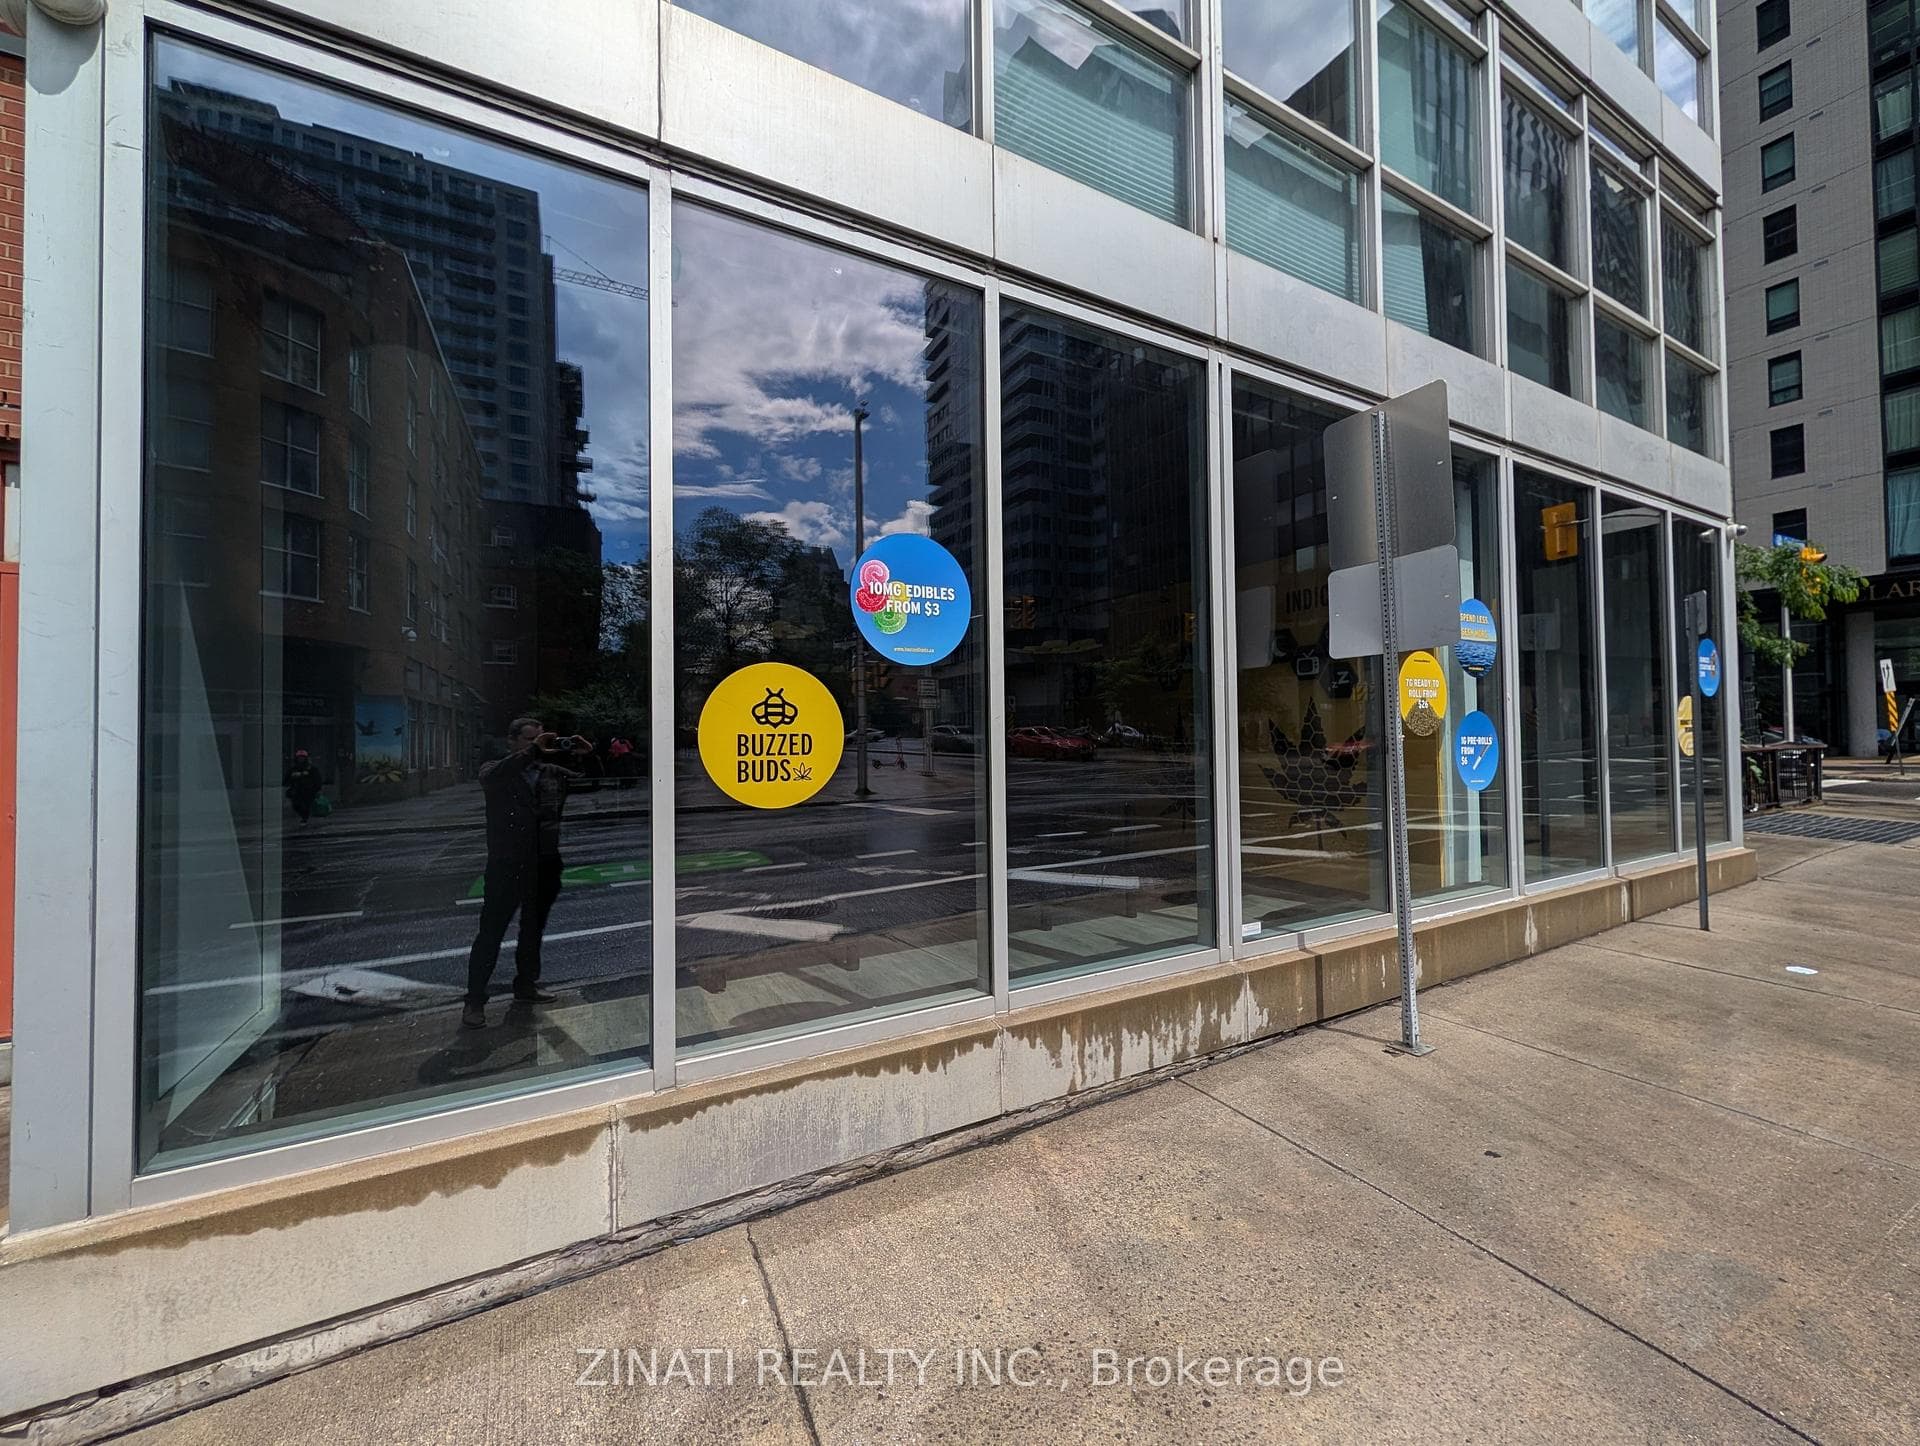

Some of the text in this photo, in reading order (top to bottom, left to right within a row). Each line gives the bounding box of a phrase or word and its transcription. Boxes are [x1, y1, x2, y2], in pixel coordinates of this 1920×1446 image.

[869, 581, 955, 601] 10MG EDIBLES
[1286, 585, 1329, 614] INDIC
[886, 599, 940, 617] FROM $3
[1413, 679, 1431, 687] READY
[1432, 679, 1440, 688] TO
[1408, 689, 1437, 698] ROLL FROM
[737, 733, 813, 757] BUZZED
[1467, 736, 1493, 745] PRE-ROLLS
[1461, 746, 1474, 755] FROM
[737, 758, 791, 783] BUDS
